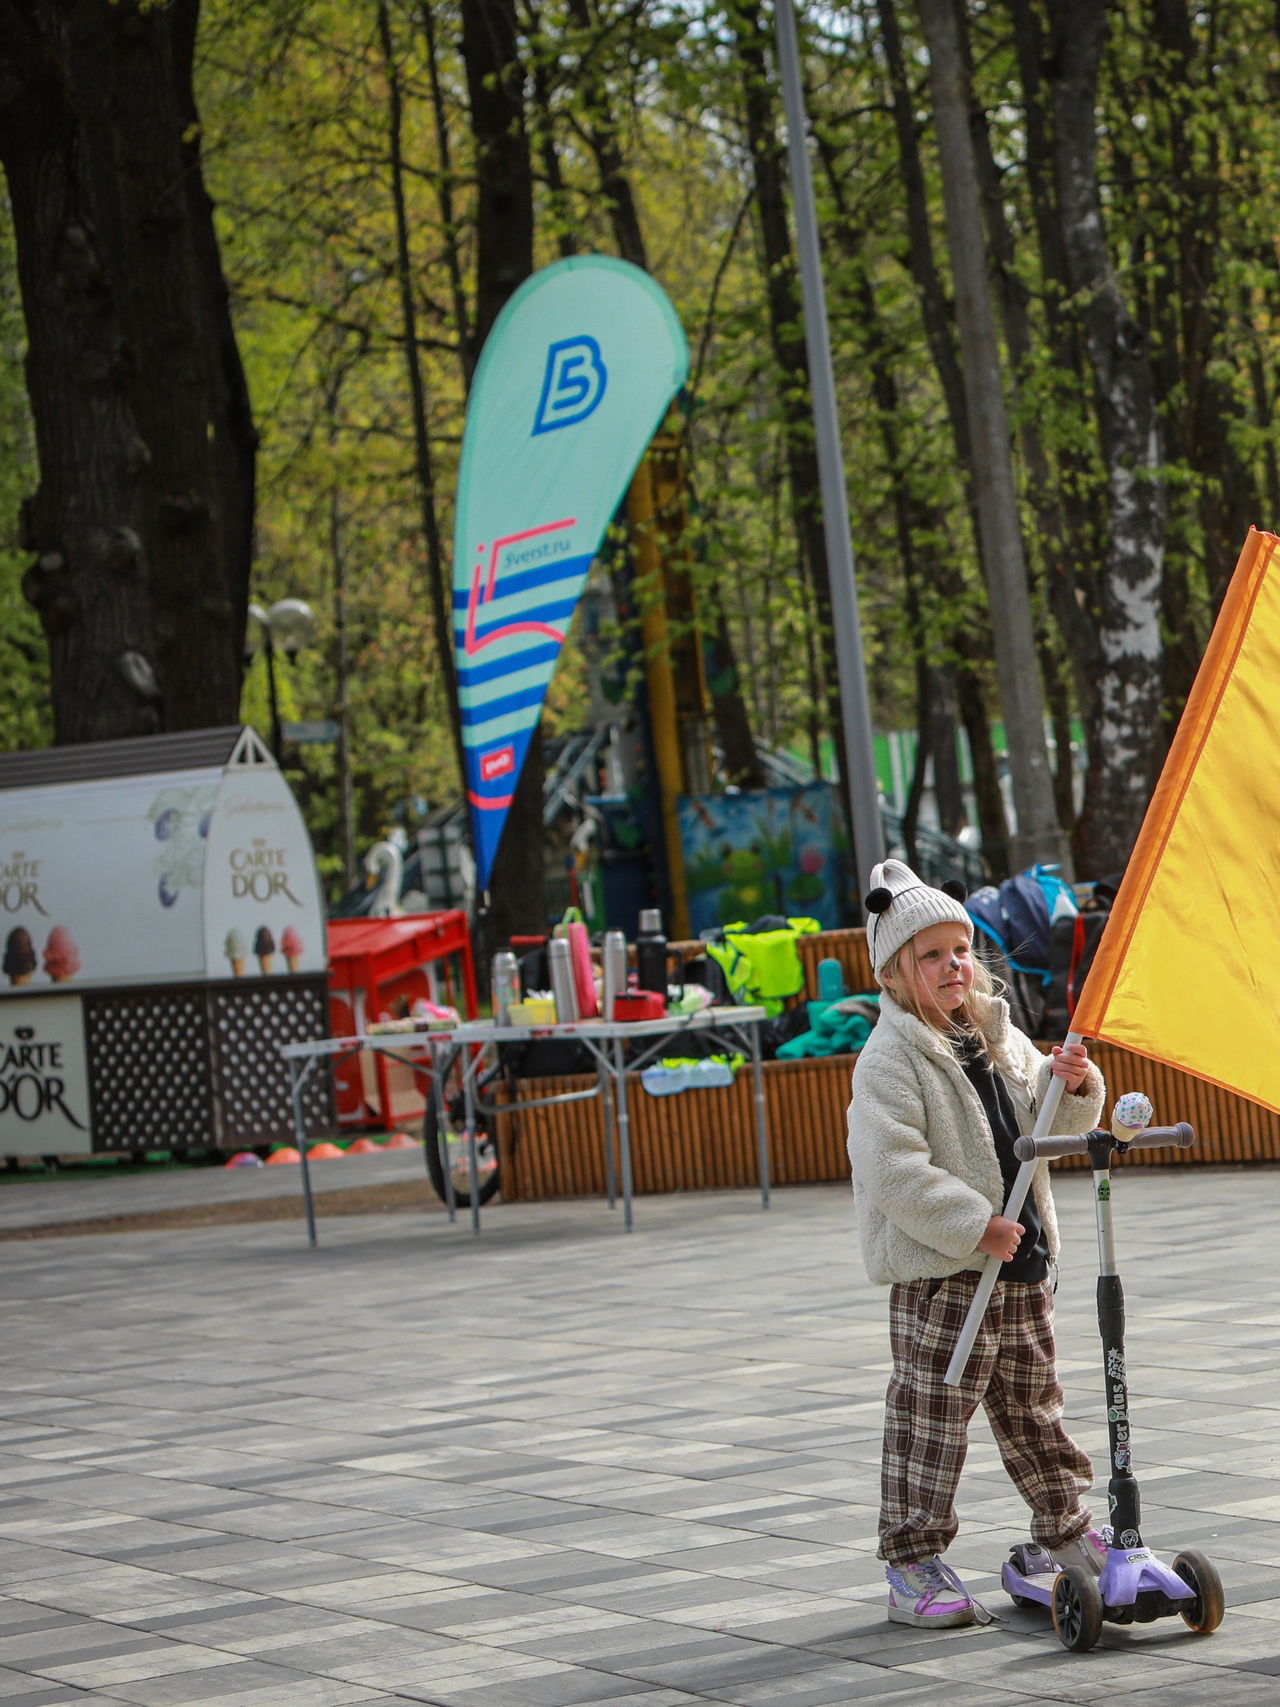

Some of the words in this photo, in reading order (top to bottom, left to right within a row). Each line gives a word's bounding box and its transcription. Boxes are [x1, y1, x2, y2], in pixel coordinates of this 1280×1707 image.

[0, 860, 40, 880] ARTE
[229, 848, 285, 871] CARTE
[0, 1042, 62, 1074] ARTE
